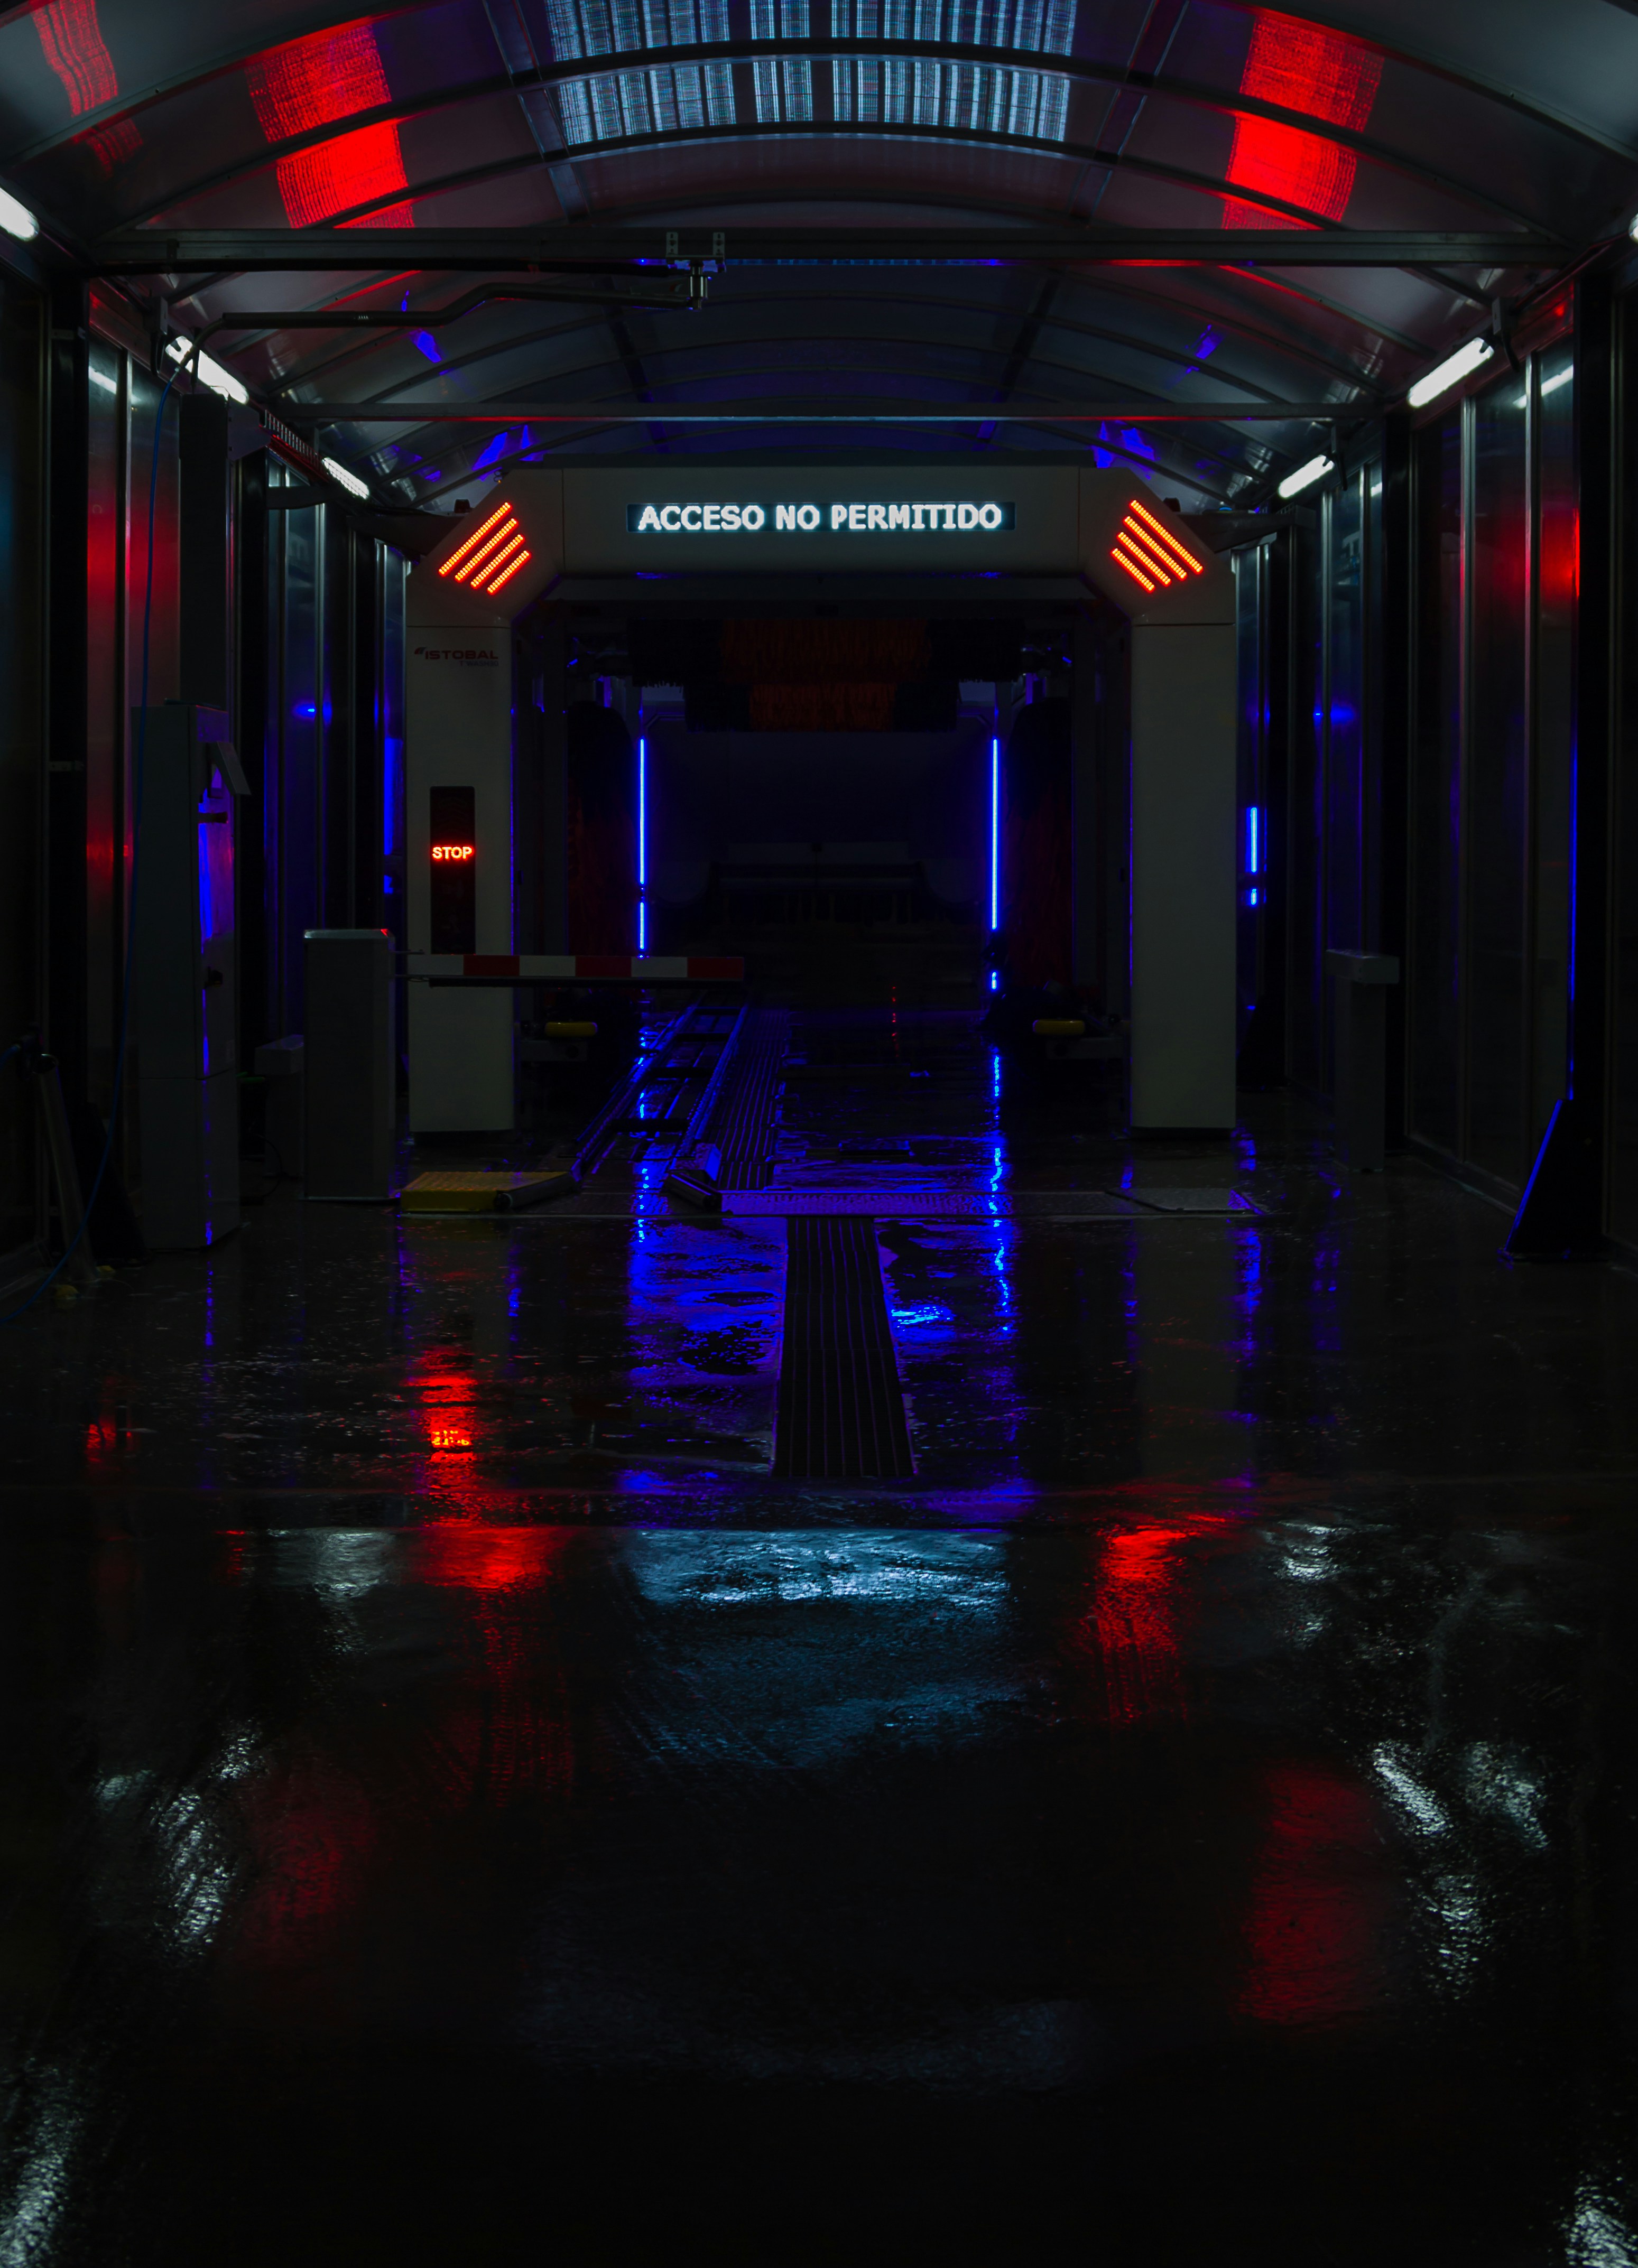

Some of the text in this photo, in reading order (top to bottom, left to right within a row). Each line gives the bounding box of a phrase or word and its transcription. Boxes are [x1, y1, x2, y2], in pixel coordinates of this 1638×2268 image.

[637, 504, 1002, 531] ACCESO NO PERMITIDO
[425, 650, 498, 659] ISTOBAL
[432, 847, 473, 859] STOP
